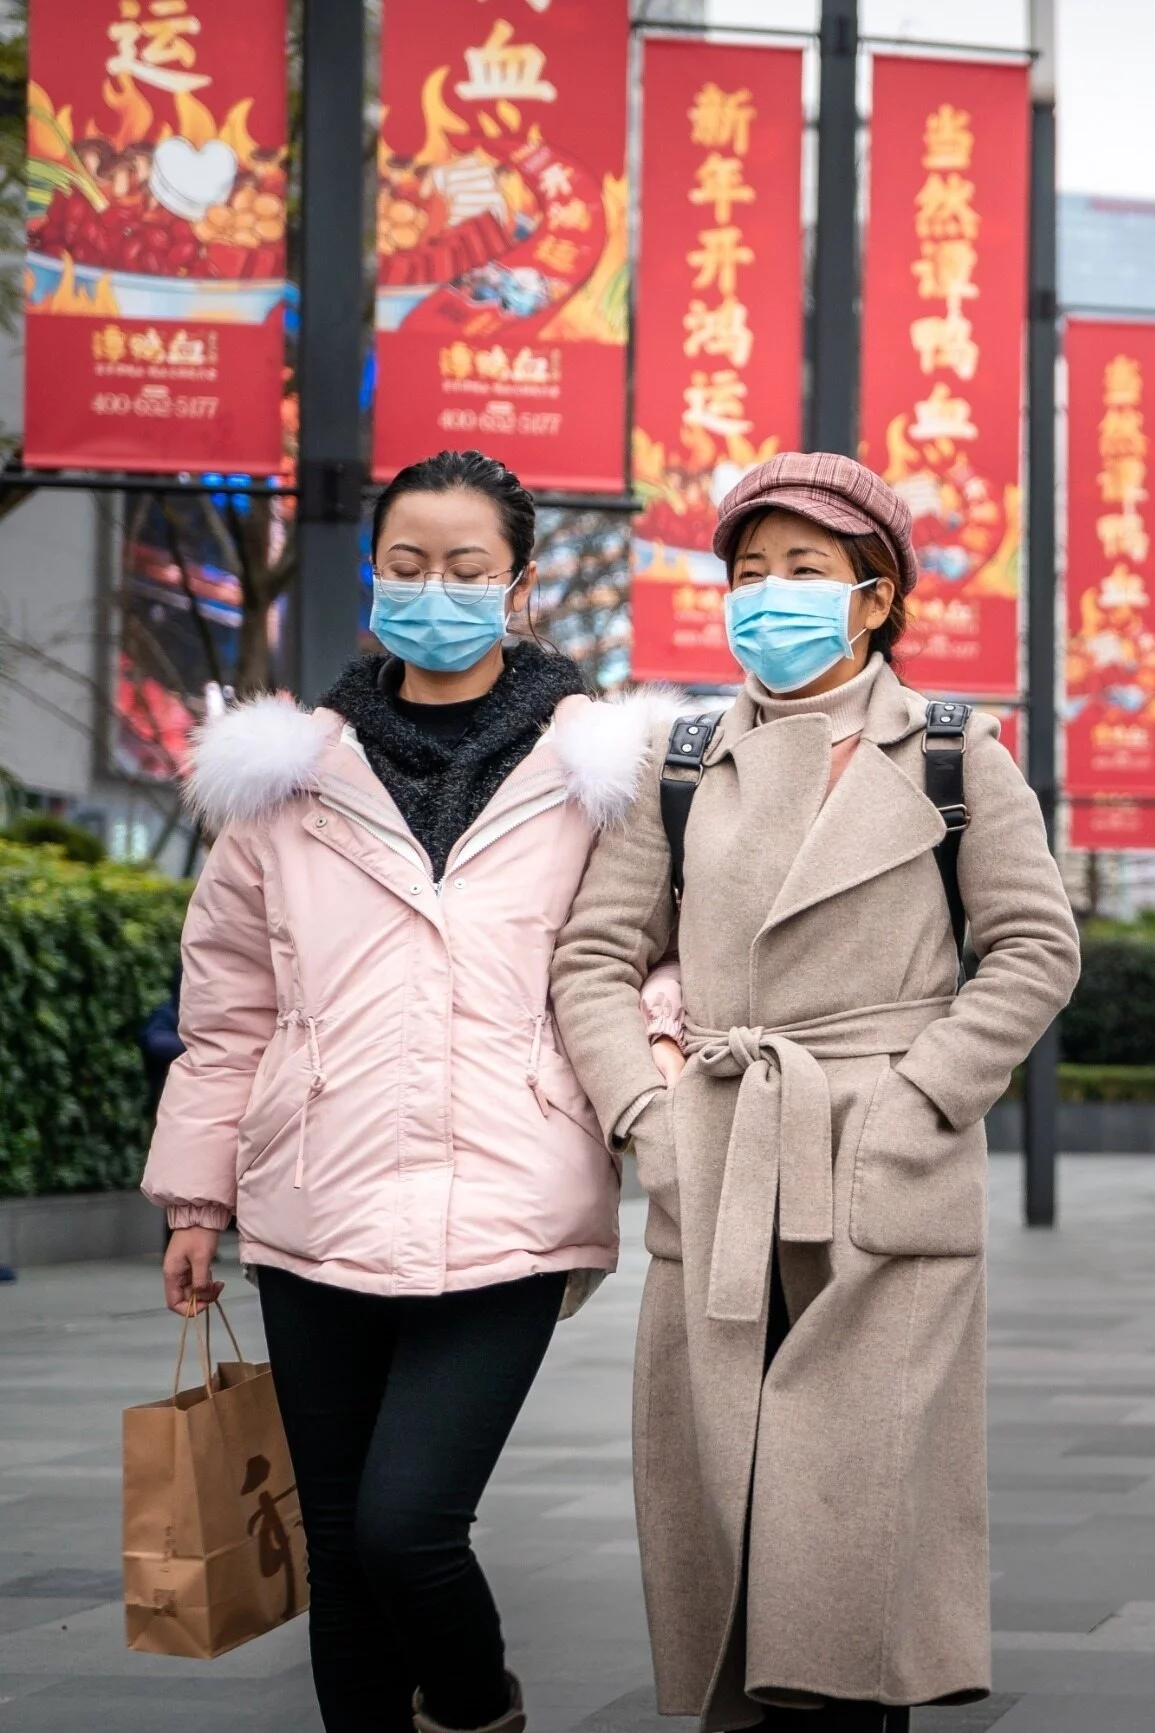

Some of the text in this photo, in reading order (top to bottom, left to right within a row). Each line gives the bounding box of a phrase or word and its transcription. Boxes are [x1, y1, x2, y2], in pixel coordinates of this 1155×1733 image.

[455, 0, 557, 101] 血
[683, 82, 756, 435] 新年开鸿运
[909, 103, 980, 439] 当然谭鸭血
